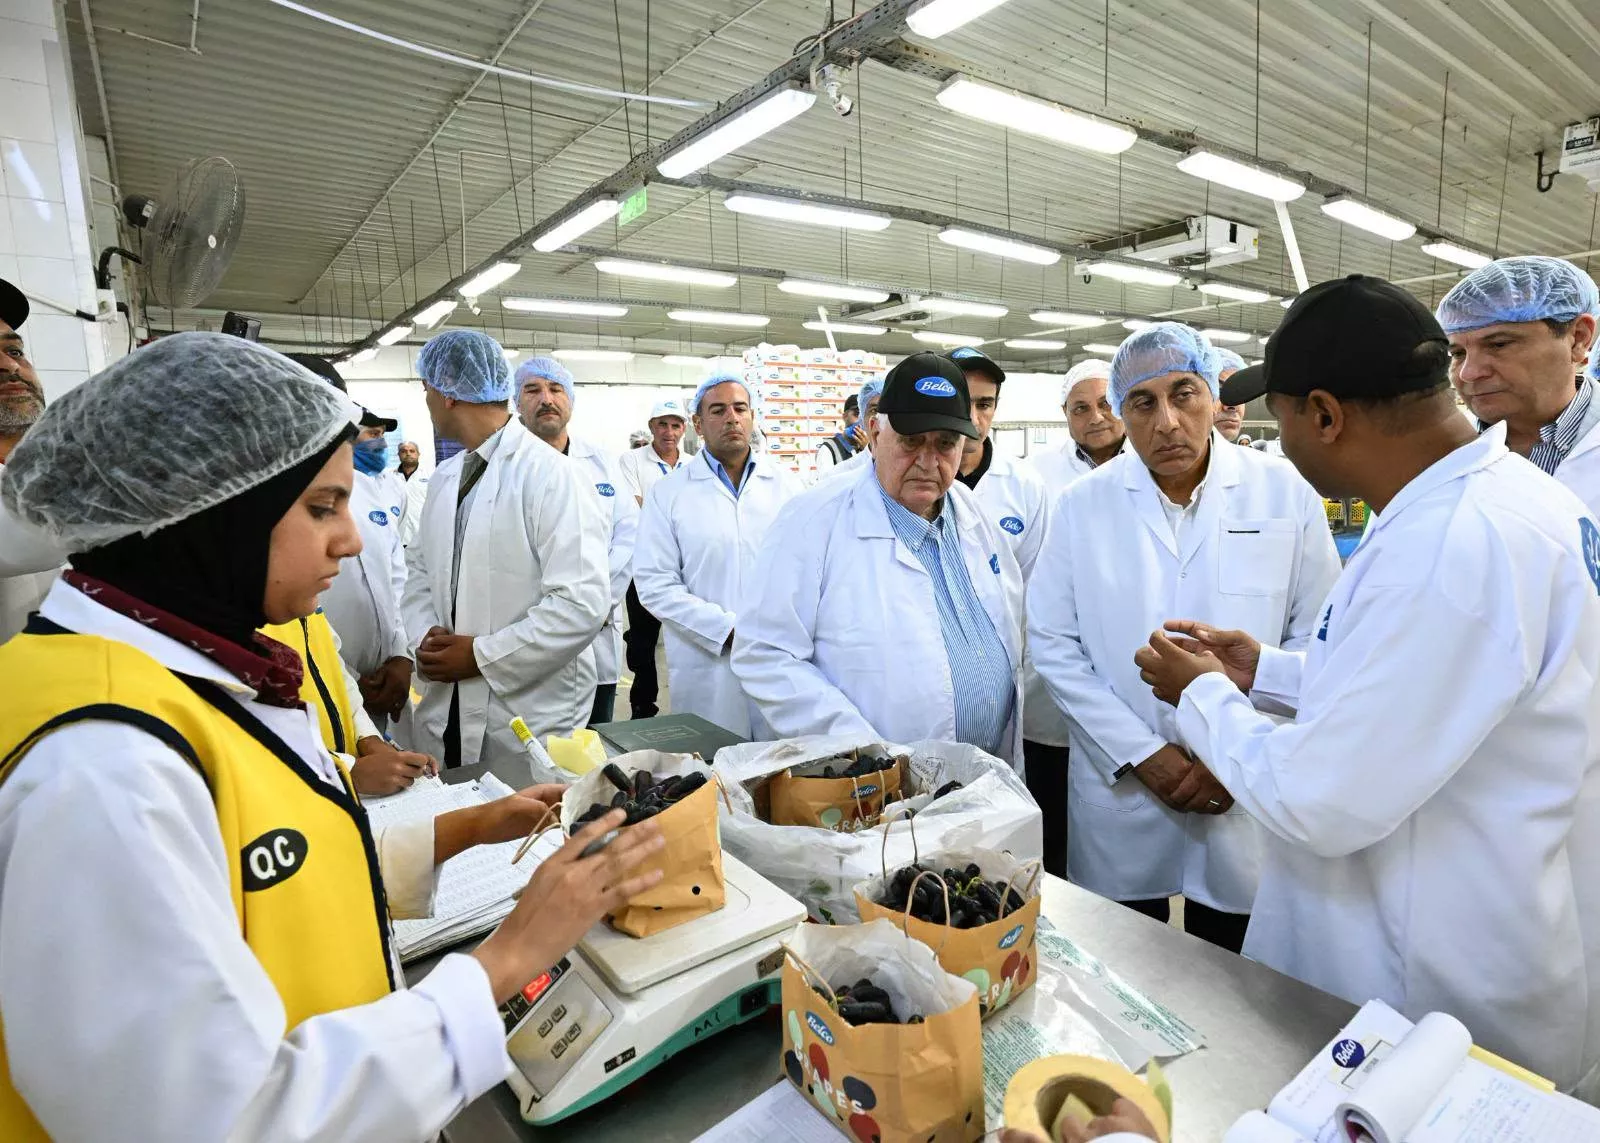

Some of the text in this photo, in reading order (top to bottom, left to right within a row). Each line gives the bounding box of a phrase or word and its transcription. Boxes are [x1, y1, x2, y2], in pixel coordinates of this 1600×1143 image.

[920, 381, 954, 393] Belco
[249, 835, 295, 880] QC
[807, 1015, 833, 1044] Belco
[1335, 1039, 1357, 1066] Belco
[795, 1044, 866, 1115] GRAPES
